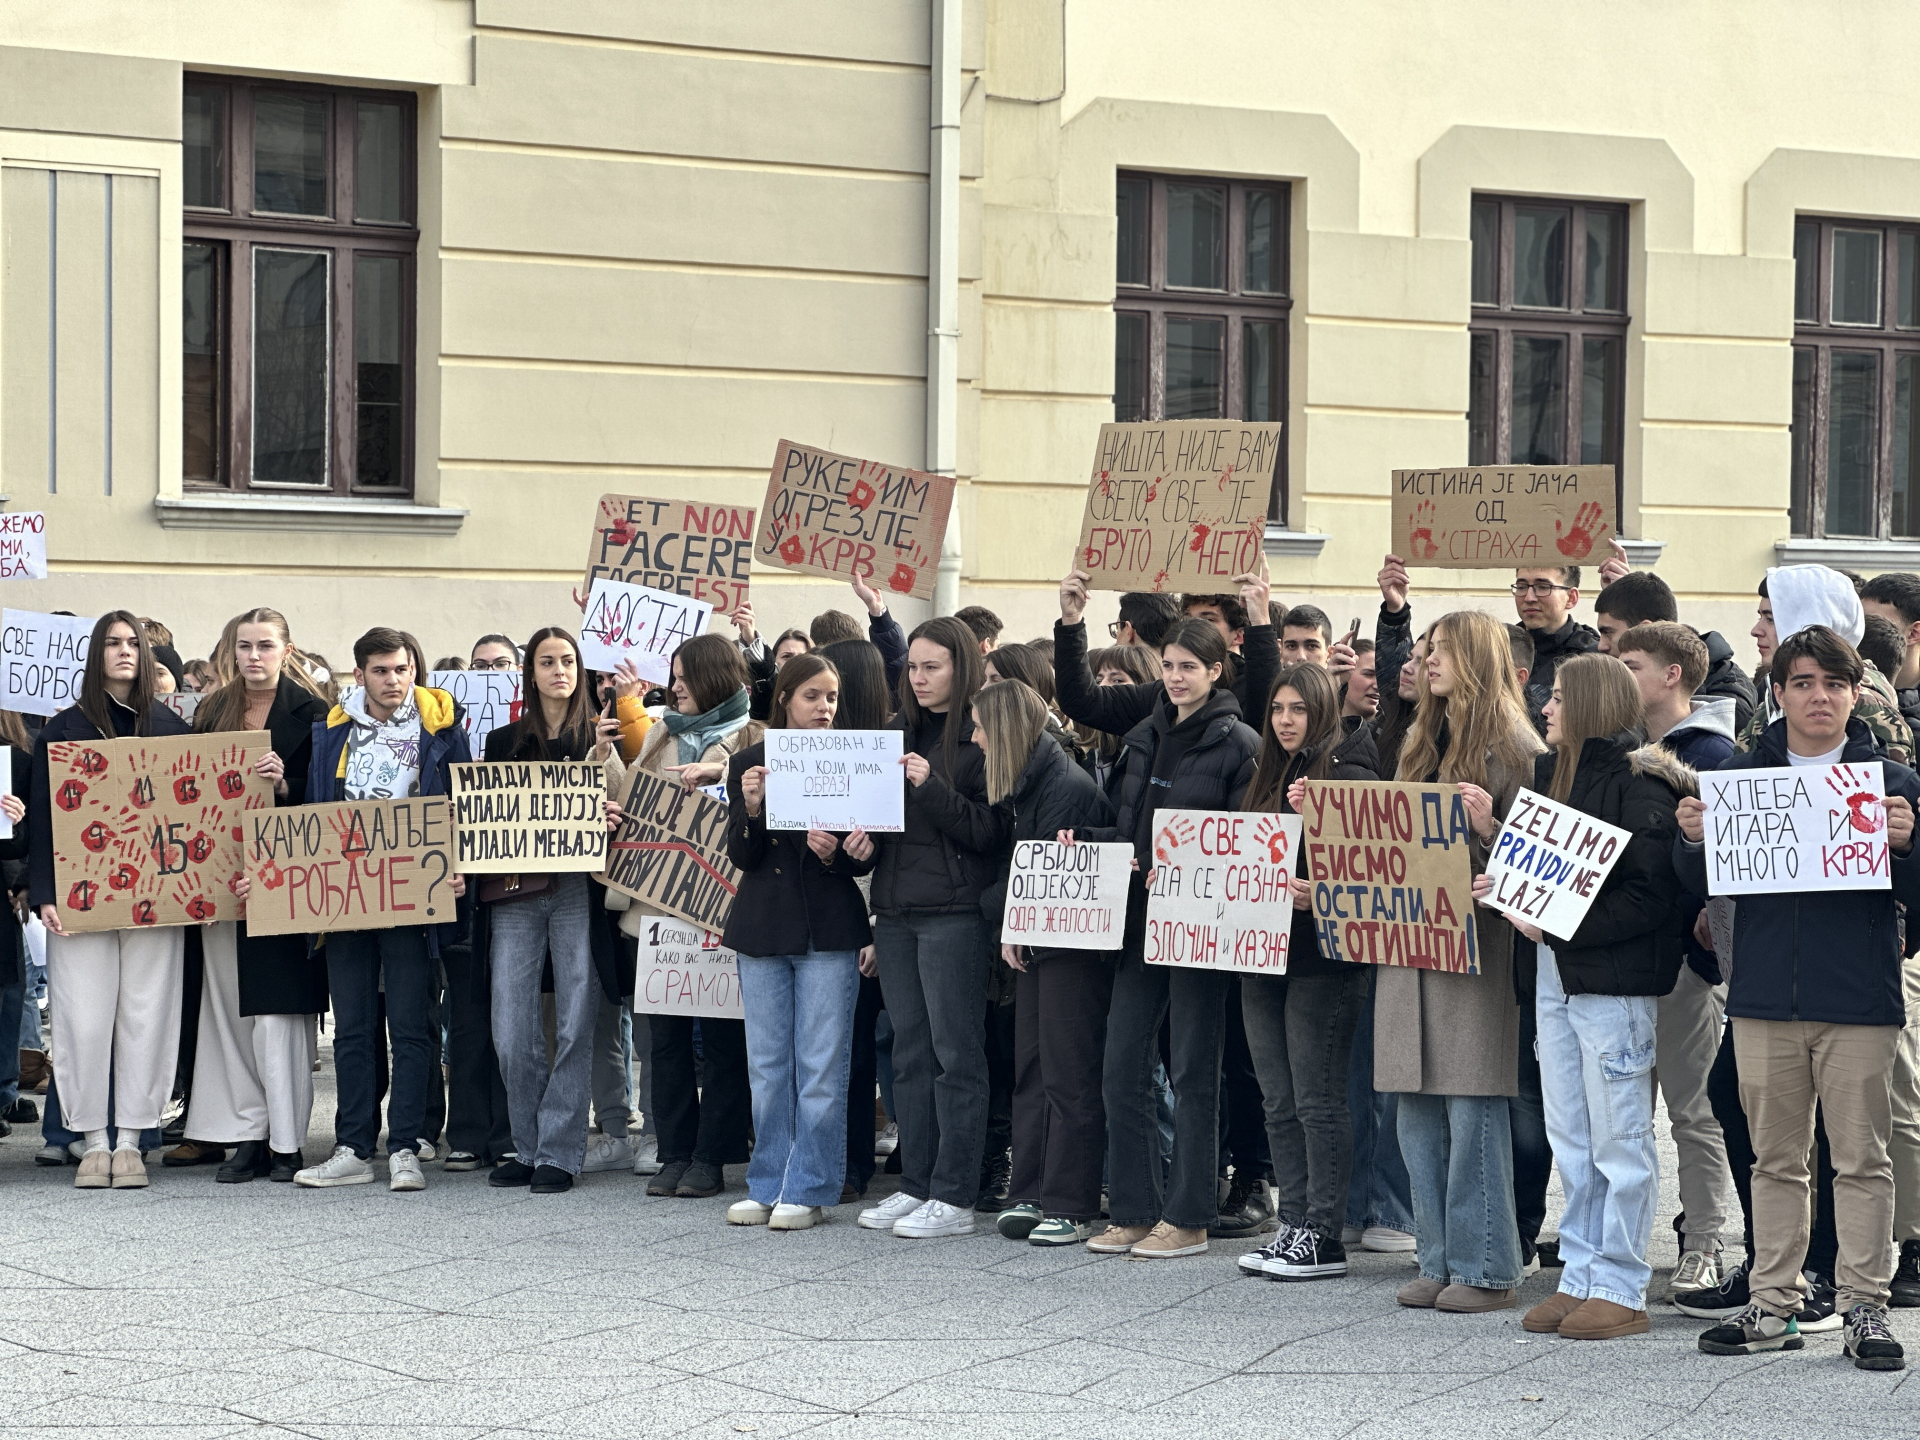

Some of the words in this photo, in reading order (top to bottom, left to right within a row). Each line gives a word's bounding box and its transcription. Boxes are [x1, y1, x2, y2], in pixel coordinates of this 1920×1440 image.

[1101, 430, 1165, 472] НИШТА
[1175, 429, 1231, 472] НИЈЕ
[1235, 430, 1280, 473] ВАМ
[782, 449, 857, 497] РУКЕ
[881, 472, 930, 513] ИМ
[1401, 471, 1483, 495] ИСТИНА
[1491, 473, 1515, 494] ЈЕ
[1524, 473, 1578, 495] ЈАЧА
[1090, 479, 1149, 525] СВЕТО,
[1162, 479, 1206, 523] СВЕ
[1222, 480, 1256, 524] ЈЕ
[1475, 500, 1507, 524] ОД
[626, 500, 670, 525] ET
[683, 505, 754, 540] NON
[773, 488, 919, 551] ОГРЕЗЛЕ
[600, 528, 752, 580] FACERE
[763, 523, 784, 555] У
[808, 533, 876, 578] КРВ
[1086, 527, 1151, 572] БРУТО
[1166, 529, 1188, 573] И
[1197, 530, 1259, 576] НЕТО
[1449, 529, 1543, 560] СТРАХА
[1, 557, 29, 577] БА
[3, 626, 37, 657] СВЕ
[778, 735, 864, 753] ОБРАЗОВАН
[872, 736, 887, 751] ЈЕ
[83, 752, 103, 773] 12
[770, 758, 805, 773] ОНАЈ
[815, 759, 846, 775] КОЈИ
[855, 762, 883, 775] ИМА
[135, 775, 155, 805] 11
[180, 779, 198, 801] 13
[224, 773, 242, 793] 10
[457, 765, 532, 792] МЛАДИ
[540, 765, 607, 793] МИСЛЕ,
[804, 774, 850, 796] ОБРАЗ!
[1712, 776, 1812, 812] ХЛЕБА
[63, 783, 81, 808] 14
[457, 793, 520, 824] МЛАДИ
[528, 793, 602, 825] ДЕЛУЈУ,
[624, 771, 693, 832] НИЈЕ
[255, 813, 321, 860] КАМО
[341, 801, 445, 858] ДАЉЕ
[1308, 786, 1413, 843] УЧИМО
[1421, 792, 1470, 850] ДА
[1715, 812, 1799, 846] ИГАРА
[1829, 809, 1852, 841] И
[88, 824, 104, 848] 9
[150, 823, 188, 875] 15
[194, 838, 205, 860] 8
[459, 829, 527, 862] МЛАДИ
[534, 829, 606, 858] МЕЊАЈУ
[1200, 817, 1244, 856] СВЕ
[1014, 842, 1100, 872] СРБИЈОМ
[1309, 843, 1406, 886] БИСМО
[1494, 831, 1575, 886] PRAVDU
[1568, 867, 1602, 898] NE
[1716, 846, 1799, 881] МНОГО
[1822, 842, 1890, 878] КРВИ
[115, 868, 128, 887] 5
[1012, 874, 1100, 901] ОДЈЕКУЈЕ
[1152, 865, 1181, 898] ДА
[1193, 867, 1215, 899] СЕ
[1225, 864, 1289, 903] САЗНА
[74, 880, 91, 911] 1
[139, 900, 152, 922] 2
[195, 901, 205, 919] 3
[1434, 886, 1458, 927] А
[648, 922, 660, 946] 1
[661, 929, 698, 946] СЕКУНДА
[1008, 906, 1036, 932] ОДА
[1042, 906, 1111, 933] ЖАЛОСТИ
[1147, 919, 1218, 963] ЗЛОЧИН
[1234, 928, 1288, 968] КАЗНА
[1314, 917, 1343, 961] НЕ
[655, 949, 680, 964] КАКО
[685, 953, 699, 964] ВАС
[709, 953, 735, 964] НИЈЕ
